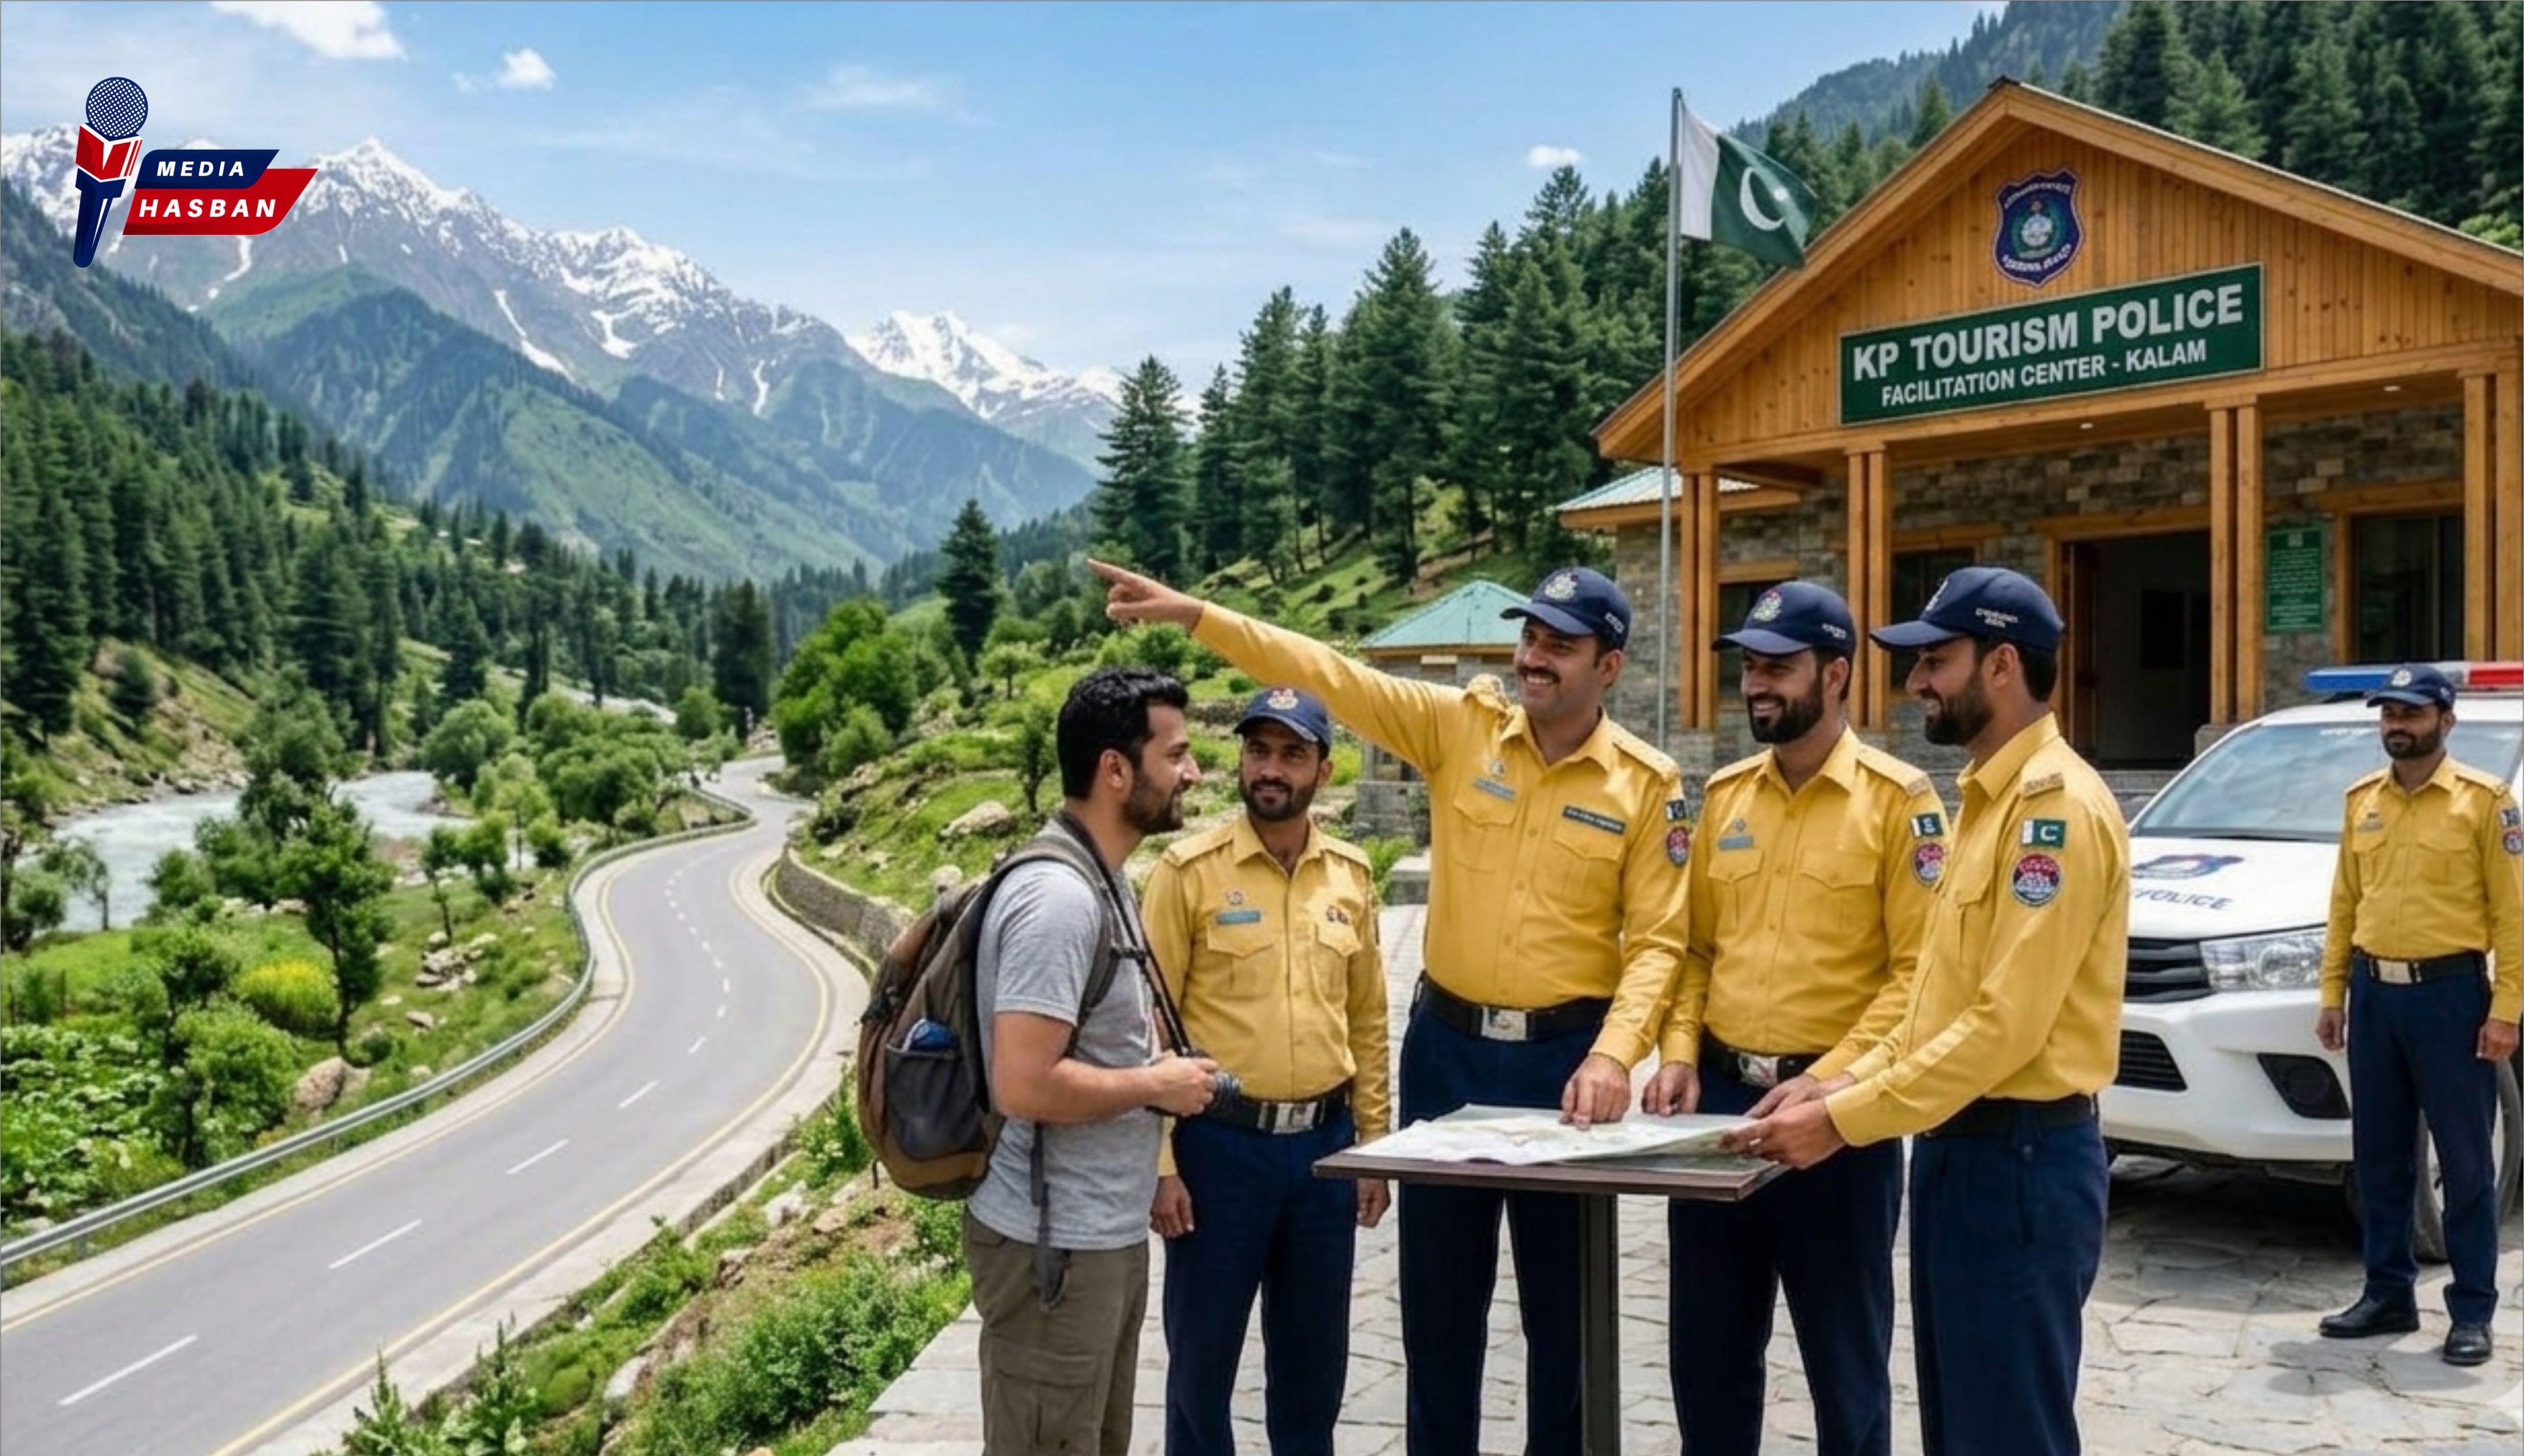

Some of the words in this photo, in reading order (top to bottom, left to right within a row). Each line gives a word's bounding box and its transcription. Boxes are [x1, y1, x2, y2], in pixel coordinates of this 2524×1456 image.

[1854, 341, 1899, 381] KP
[1910, 310, 2078, 372] TOURISM
[2092, 283, 2243, 344] POLICE
[1881, 367, 2015, 407] FACILITATION
[2021, 354, 2106, 387] CENTER
[2125, 339, 2207, 373] KALAM
